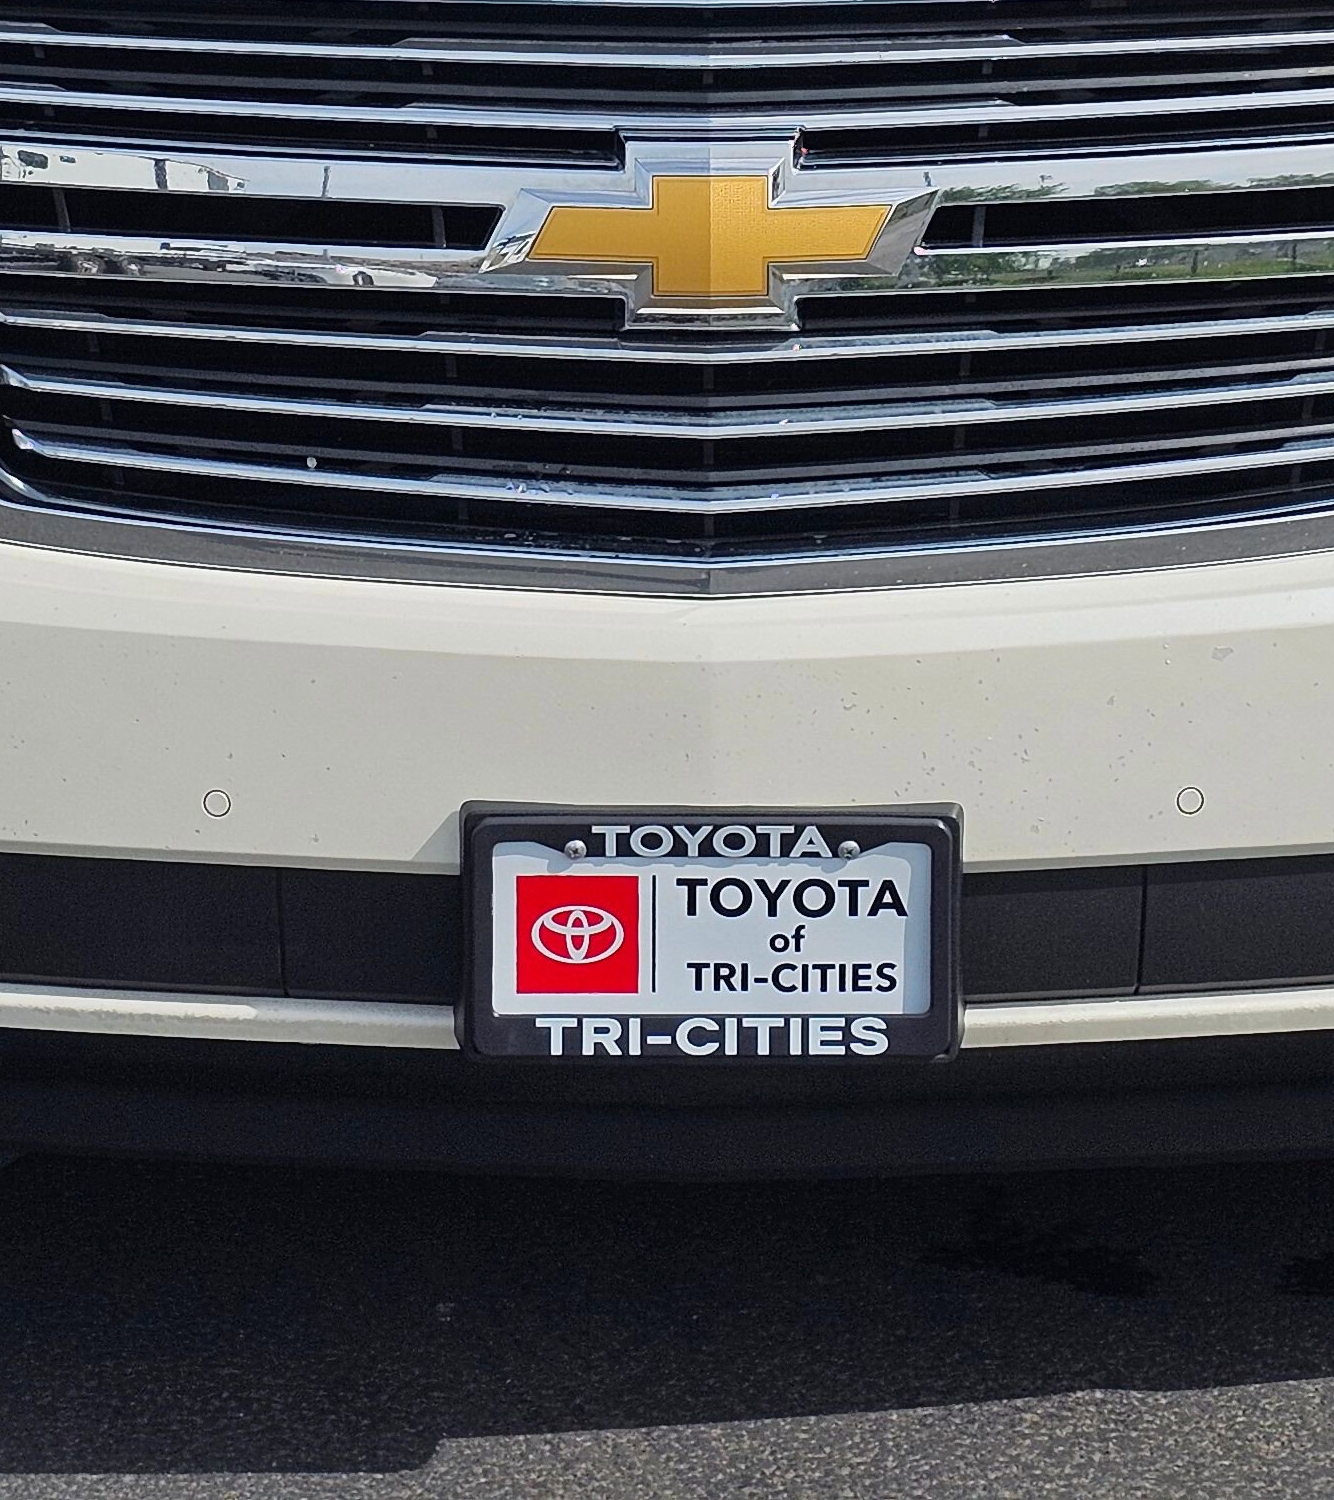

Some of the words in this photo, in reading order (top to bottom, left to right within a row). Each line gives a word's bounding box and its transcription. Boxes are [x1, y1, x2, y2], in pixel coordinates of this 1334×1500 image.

[592, 825, 834, 858] TOYOTA
[676, 877, 908, 918] TOYOTA
[768, 924, 806, 953] of
[687, 962, 898, 993] TRI-CITIES
[535, 1016, 889, 1057] TRI-CITIES
